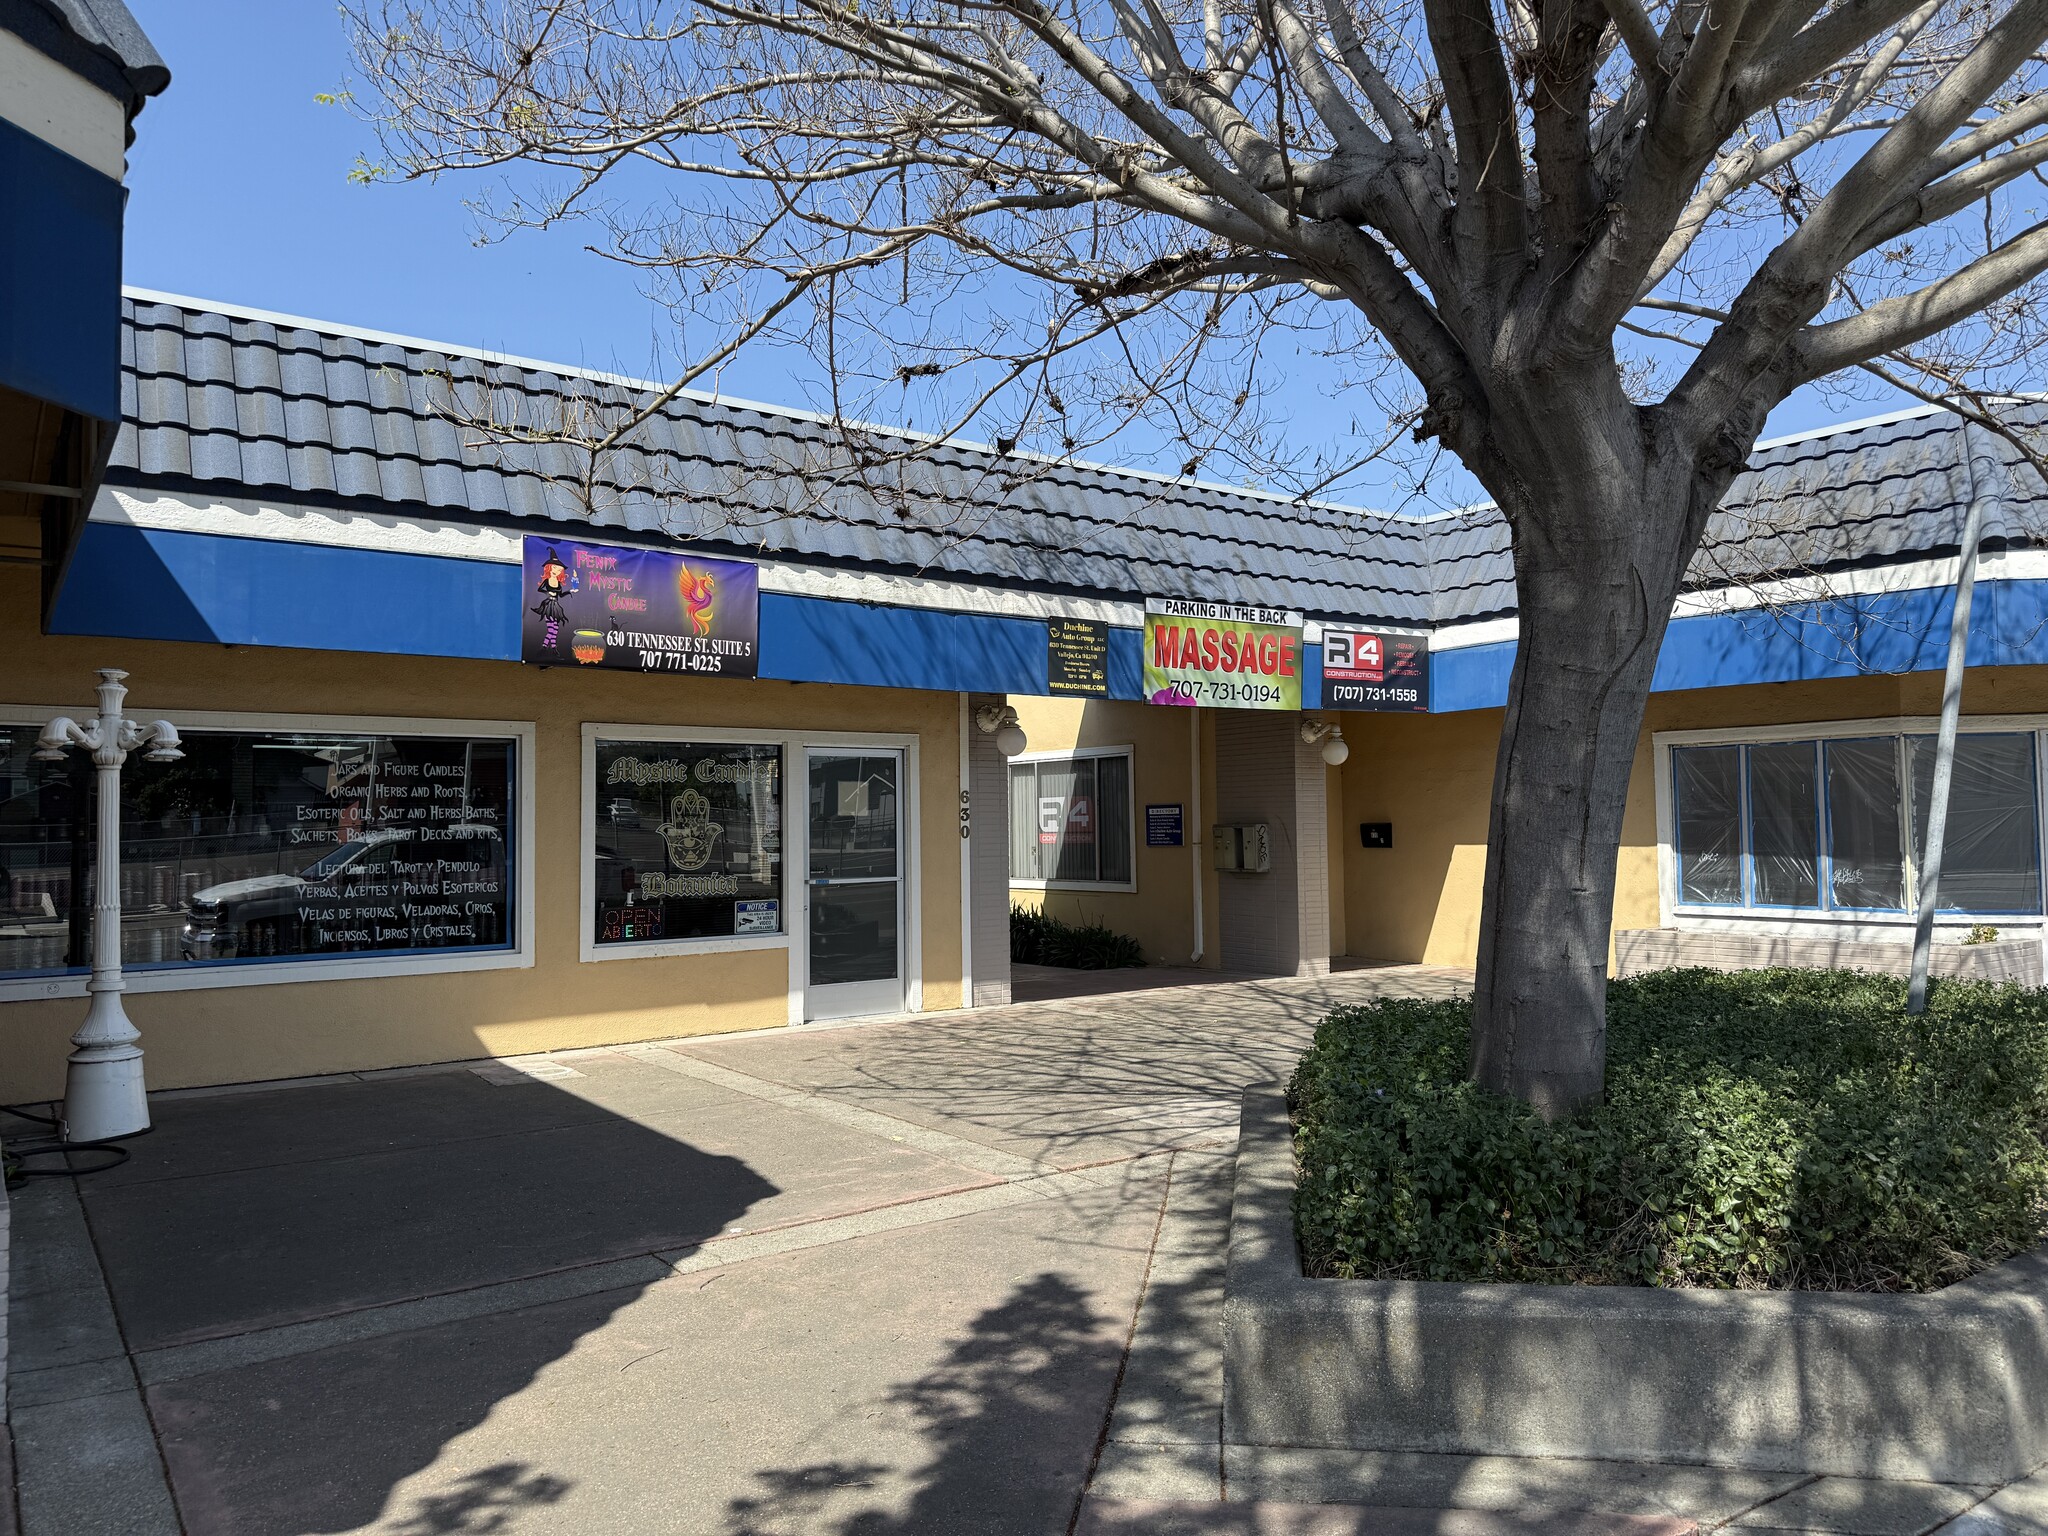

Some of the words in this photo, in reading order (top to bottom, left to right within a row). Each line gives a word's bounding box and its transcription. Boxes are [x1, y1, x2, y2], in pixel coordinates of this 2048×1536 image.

[1165, 600, 1216, 617] PARKING
[1219, 605, 1231, 619] IN
[1235, 607, 1256, 622] THE
[1259, 610, 1287, 625] BACK
[606, 630, 625, 647] 630
[626, 631, 692, 652] TENNESSEE
[694, 637, 710, 653] ST.
[711, 639, 743, 656] SUITE
[744, 642, 751, 657] 5
[1061, 633, 1076, 641] Auto
[1076, 634, 1096, 644] Group
[1155, 625, 1296, 677] MASSAGE
[639, 650, 662, 669] 707
[665, 653, 722, 672] 771-0225
[1326, 670, 1376, 679] CONSTRUCTION
[1049, 682, 1106, 691] WWW.DUCHINE.COM
[1170, 680, 1280, 702] 707-731-0194
[1333, 685, 1364, 702] (707)
[1366, 687, 1418, 702] 731-1558
[384, 762, 419, 777] FIGURE
[607, 756, 687, 786] Mystic
[330, 785, 370, 798] ORGANIC
[375, 784, 408, 798] HERBS
[411, 787, 430, 798] AND
[296, 805, 346, 820] ESOTERIC
[379, 805, 405, 820] SALT
[407, 808, 427, 819] AND
[455, 829, 474, 840] AND
[368, 863, 388, 874] DEL
[390, 860, 423, 875] TAROT
[437, 859, 480, 874] PENDULO
[403, 881, 439, 897] POLVOS
[442, 880, 498, 895] ESOTERICOS
[641, 871, 739, 900] Botanica
[298, 906, 335, 922] VELAS
[339, 908, 351, 920] DE
[746, 902, 768, 911] NOTICE
[605, 909, 660, 925] OPEN
[602, 923, 662, 939] ABIERTO
